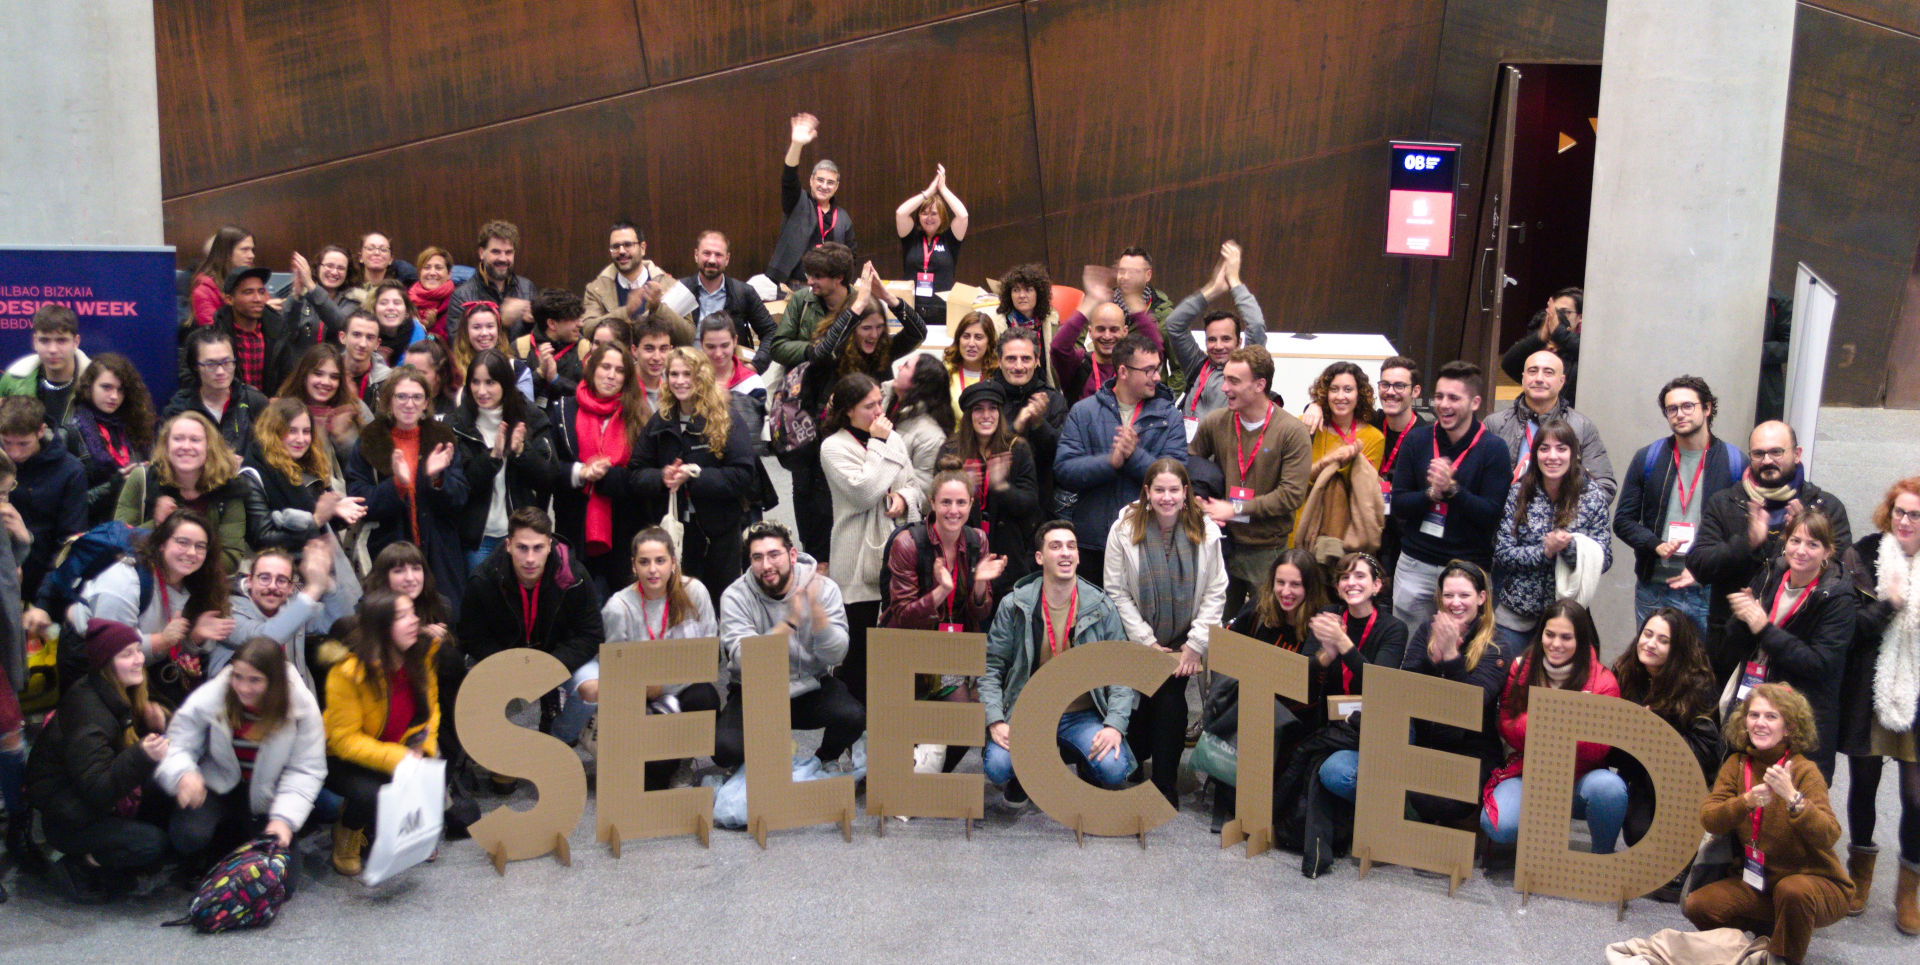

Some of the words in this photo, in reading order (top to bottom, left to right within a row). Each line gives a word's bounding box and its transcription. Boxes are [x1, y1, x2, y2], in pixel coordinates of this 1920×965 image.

[0, 286, 40, 297] ILBAO
[44, 286, 94, 298] BIZKAIA
[75, 301, 138, 316] WEEK
[454, 625, 1706, 903] SELECTED
